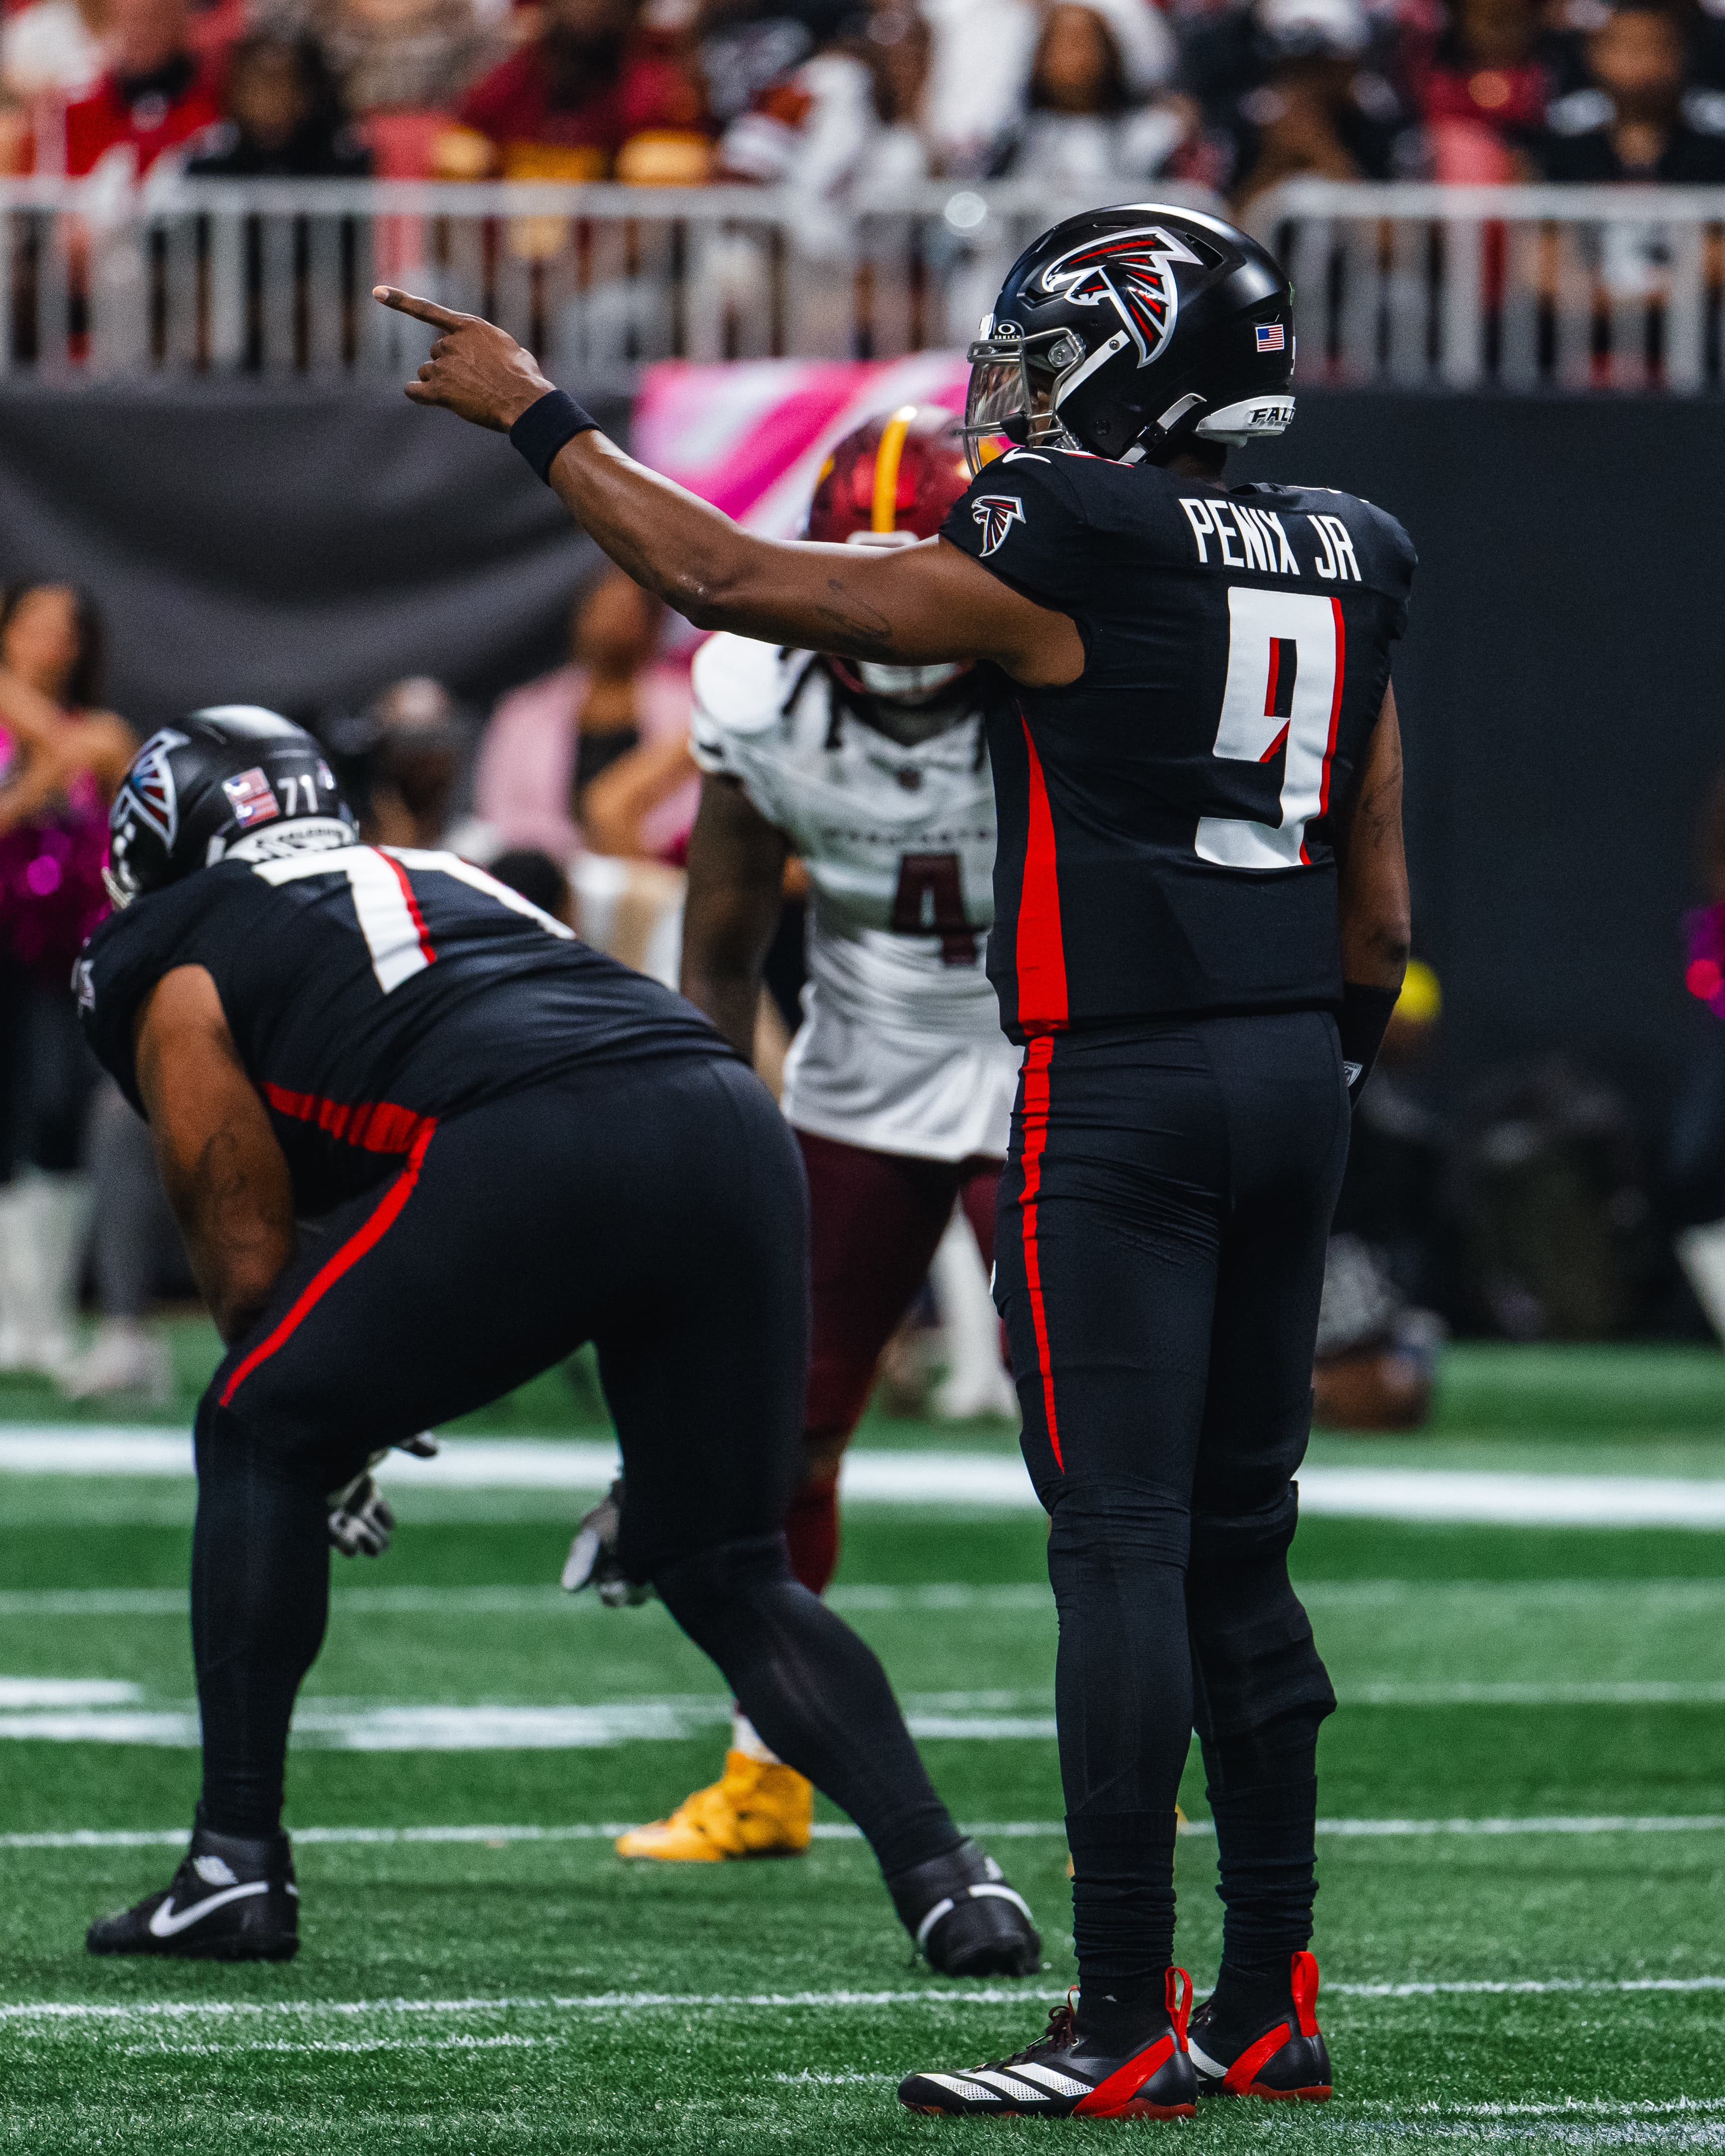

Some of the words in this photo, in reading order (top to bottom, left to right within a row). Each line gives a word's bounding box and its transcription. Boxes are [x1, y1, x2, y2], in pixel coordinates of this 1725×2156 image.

[1179, 498, 1300, 575] PENIX
[1307, 515, 1362, 582] JR
[1195, 586, 1345, 869] 9
[277, 775, 318, 816] 71
[891, 853, 981, 965] 4
